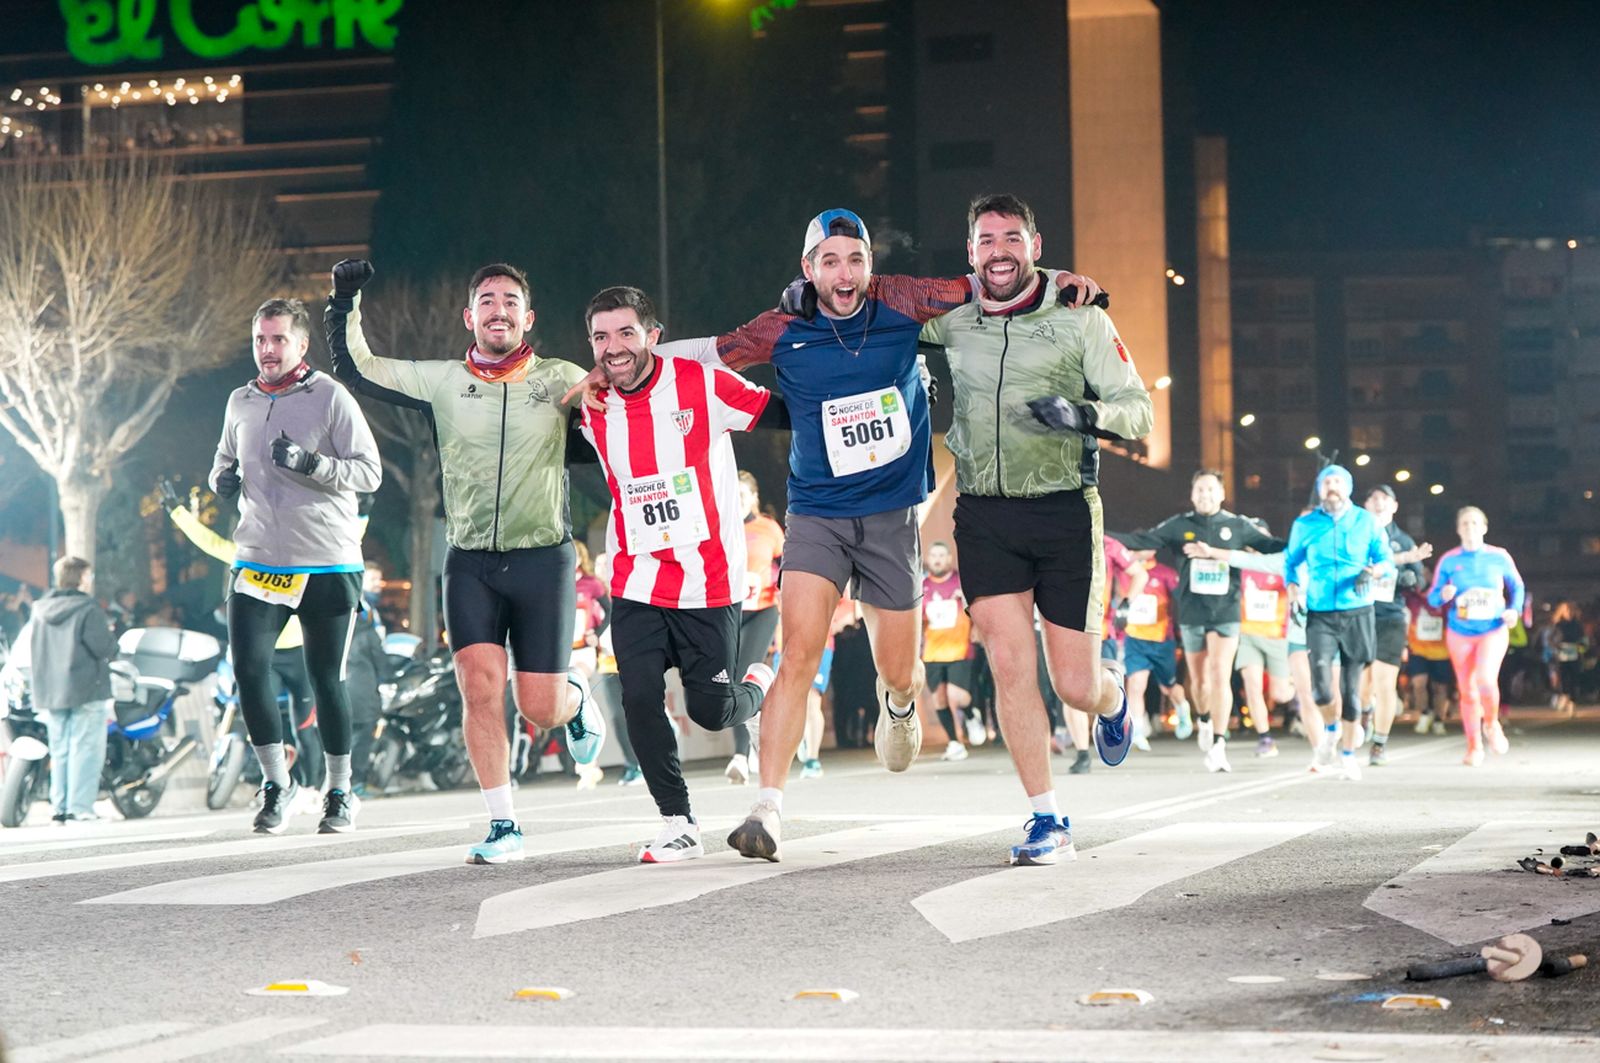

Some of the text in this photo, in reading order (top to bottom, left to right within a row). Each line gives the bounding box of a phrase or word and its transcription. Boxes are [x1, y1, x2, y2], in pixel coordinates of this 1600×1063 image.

[839, 403, 863, 414] NOCHE
[864, 400, 874, 409] DE
[831, 416, 848, 426] SAN
[841, 417, 894, 447] 5061
[634, 483, 656, 494] NOCHE
[656, 481, 666, 490] DE
[629, 495, 642, 505] SAN
[642, 499, 680, 526] 816
